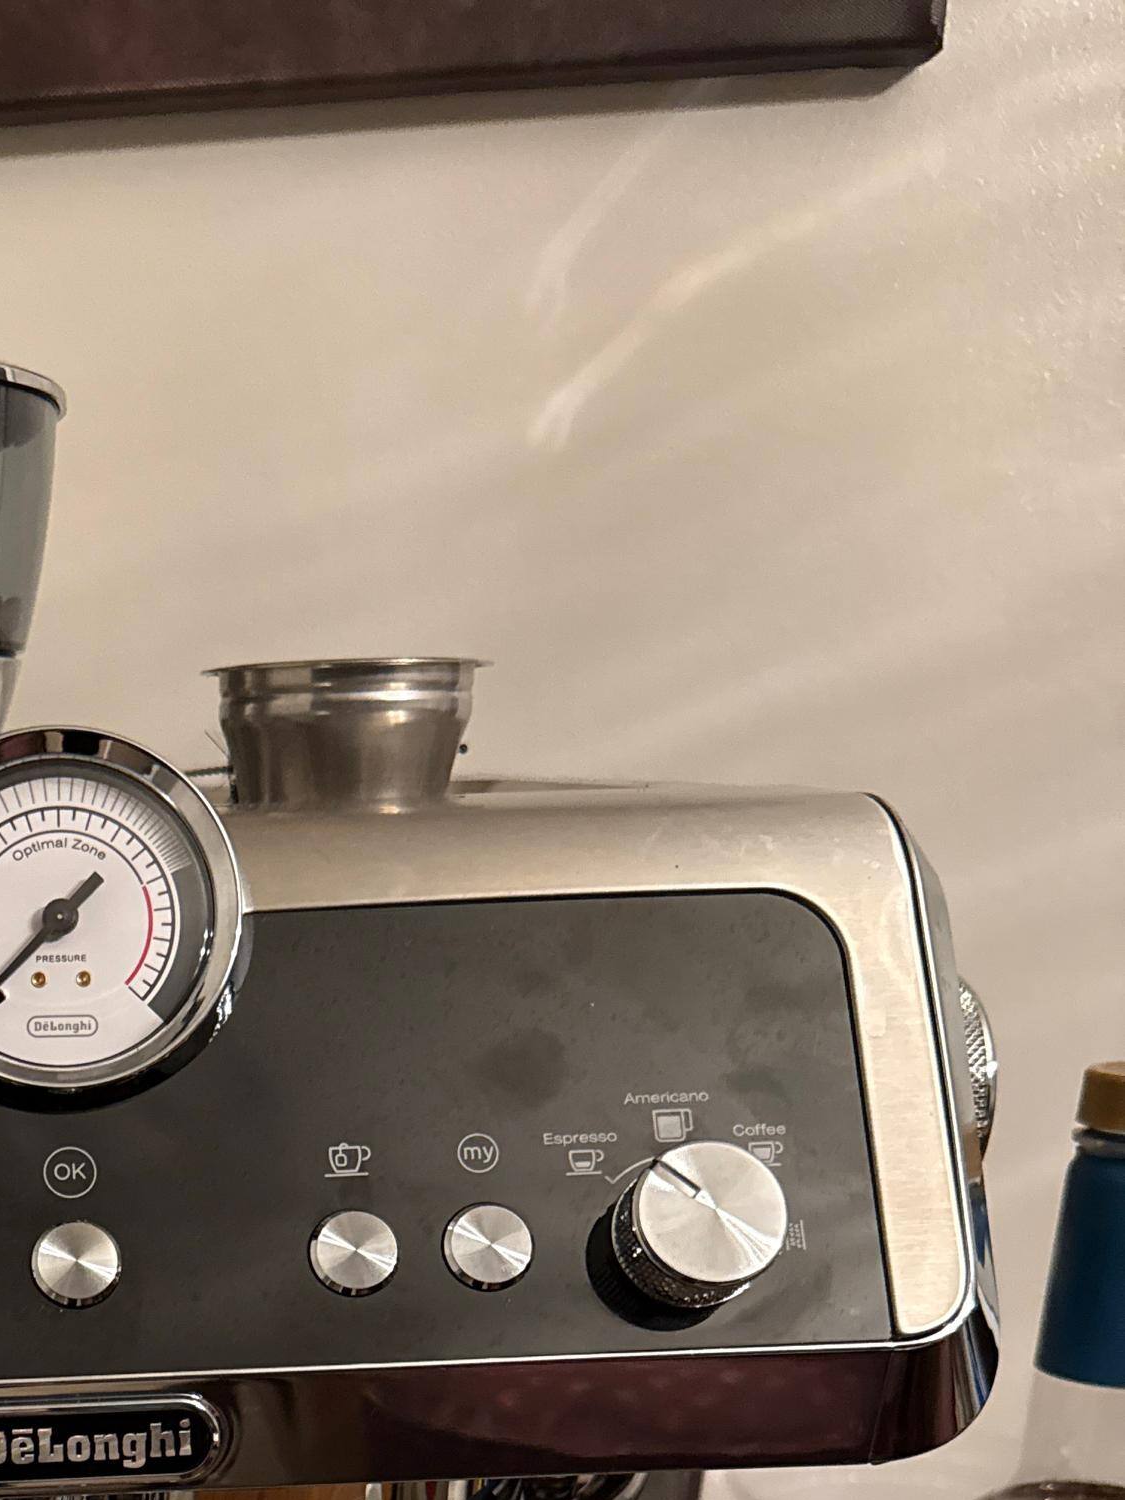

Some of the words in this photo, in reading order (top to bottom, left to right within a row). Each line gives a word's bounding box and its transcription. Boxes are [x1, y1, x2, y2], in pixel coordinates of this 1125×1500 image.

[12, 837, 67, 862] Optimal
[71, 838, 107, 861] Zone
[35, 953, 88, 964] PRESSURE
[624, 1090, 709, 1105] Americano
[543, 1129, 618, 1146] Espresso
[732, 1123, 787, 1137] Coffee
[463, 1144, 494, 1164] my
[53, 1162, 87, 1181] OK
